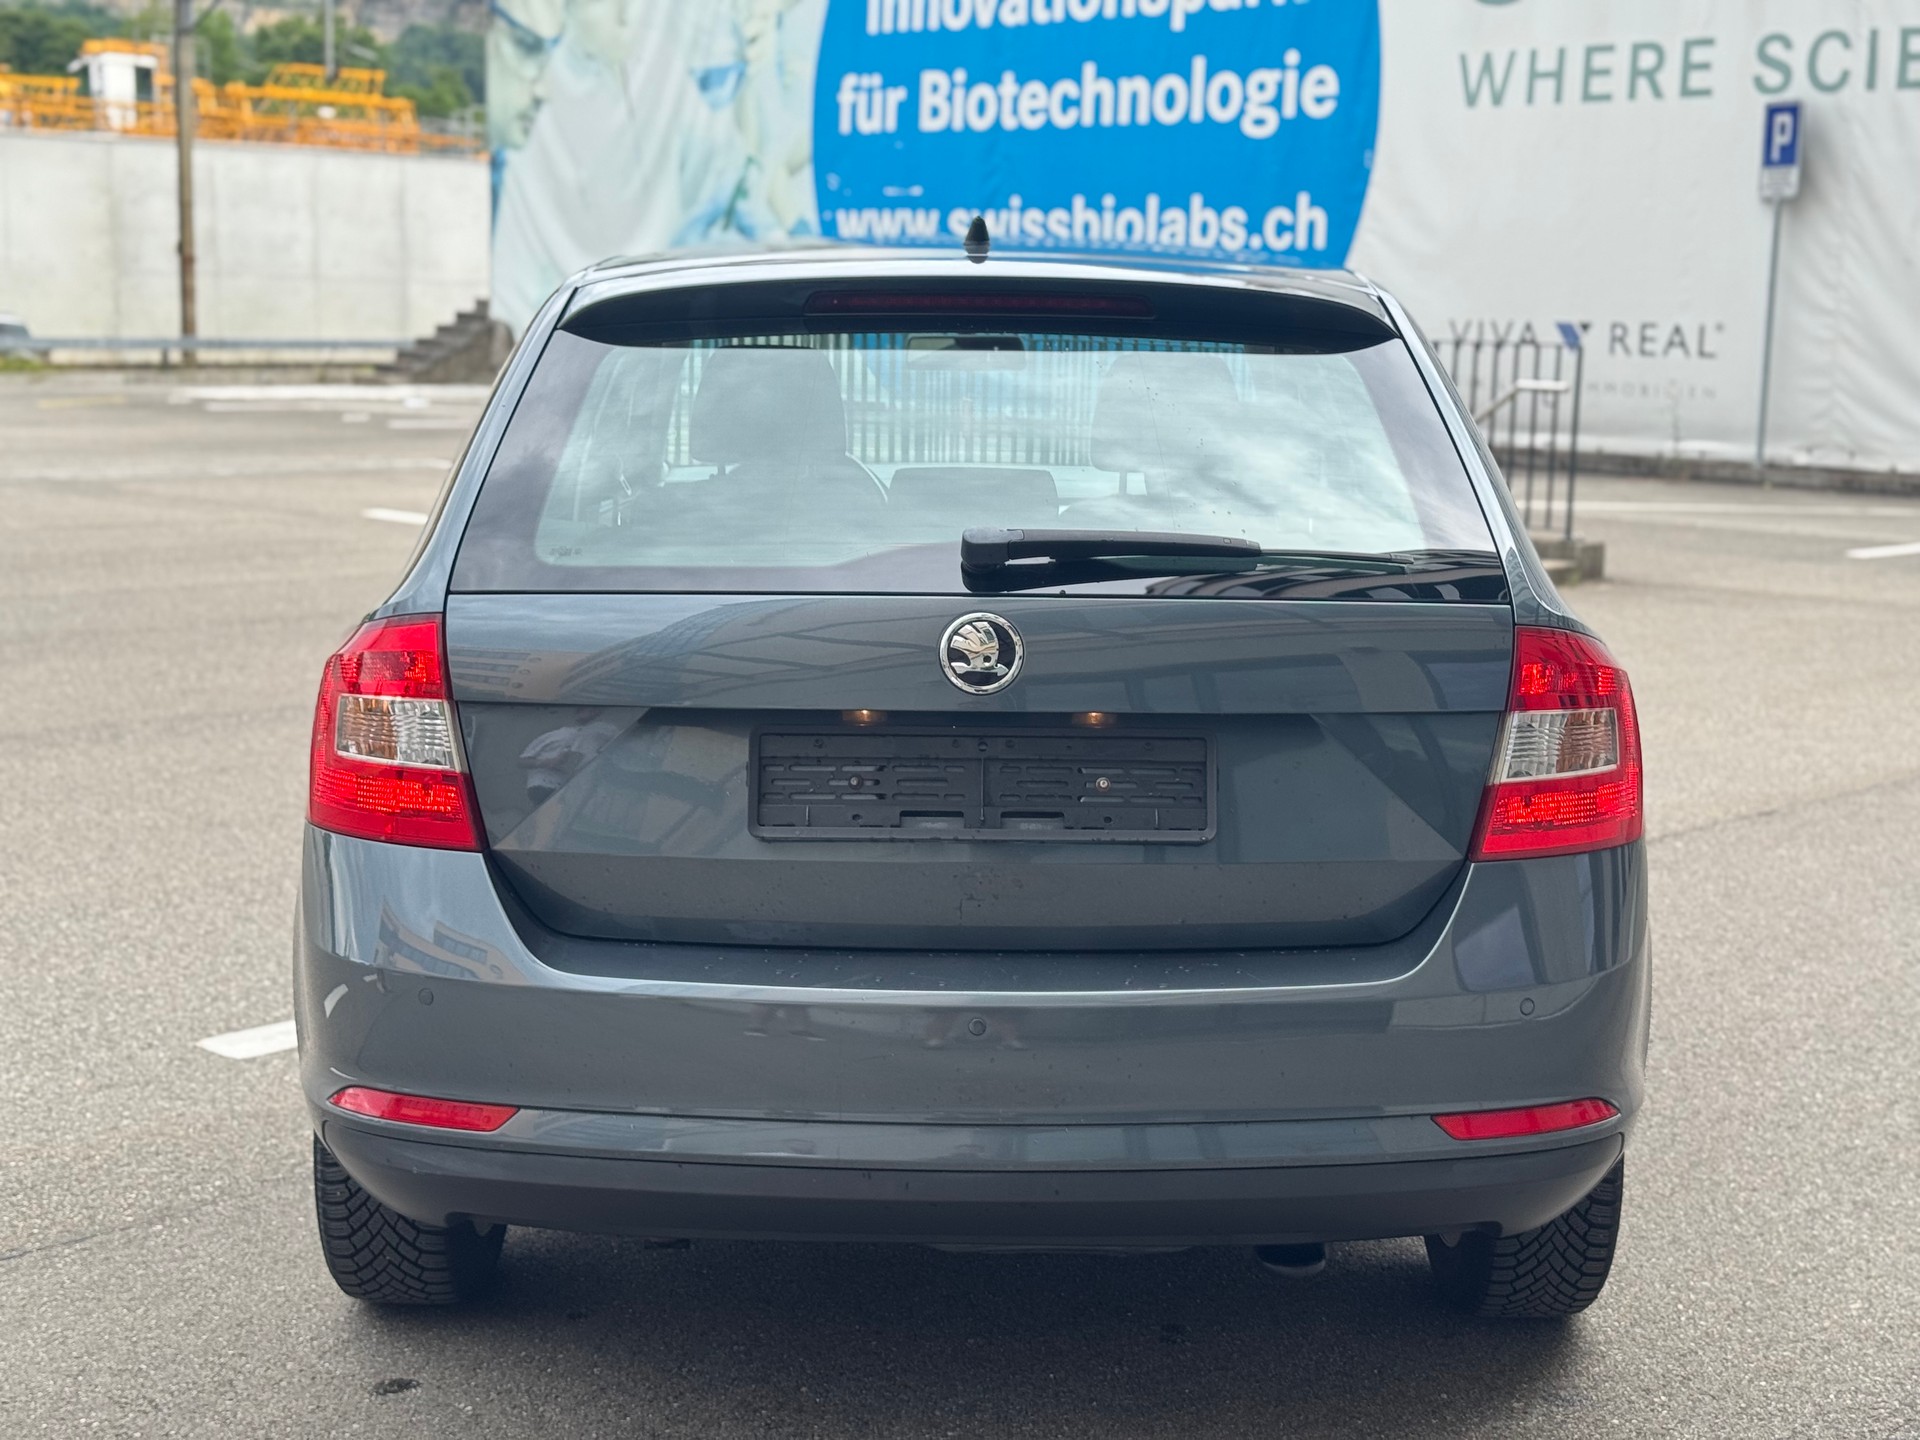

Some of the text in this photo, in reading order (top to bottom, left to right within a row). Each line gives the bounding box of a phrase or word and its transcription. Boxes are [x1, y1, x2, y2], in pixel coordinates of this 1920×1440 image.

[838, 48, 1340, 139] für Biotechnologie
[1460, 38, 1716, 108] WHERE
[1770, 112, 1795, 163] P
[834, 191, 1329, 251] wwwswissbiolabs.ch
[1451, 319, 1539, 347] VIVA
